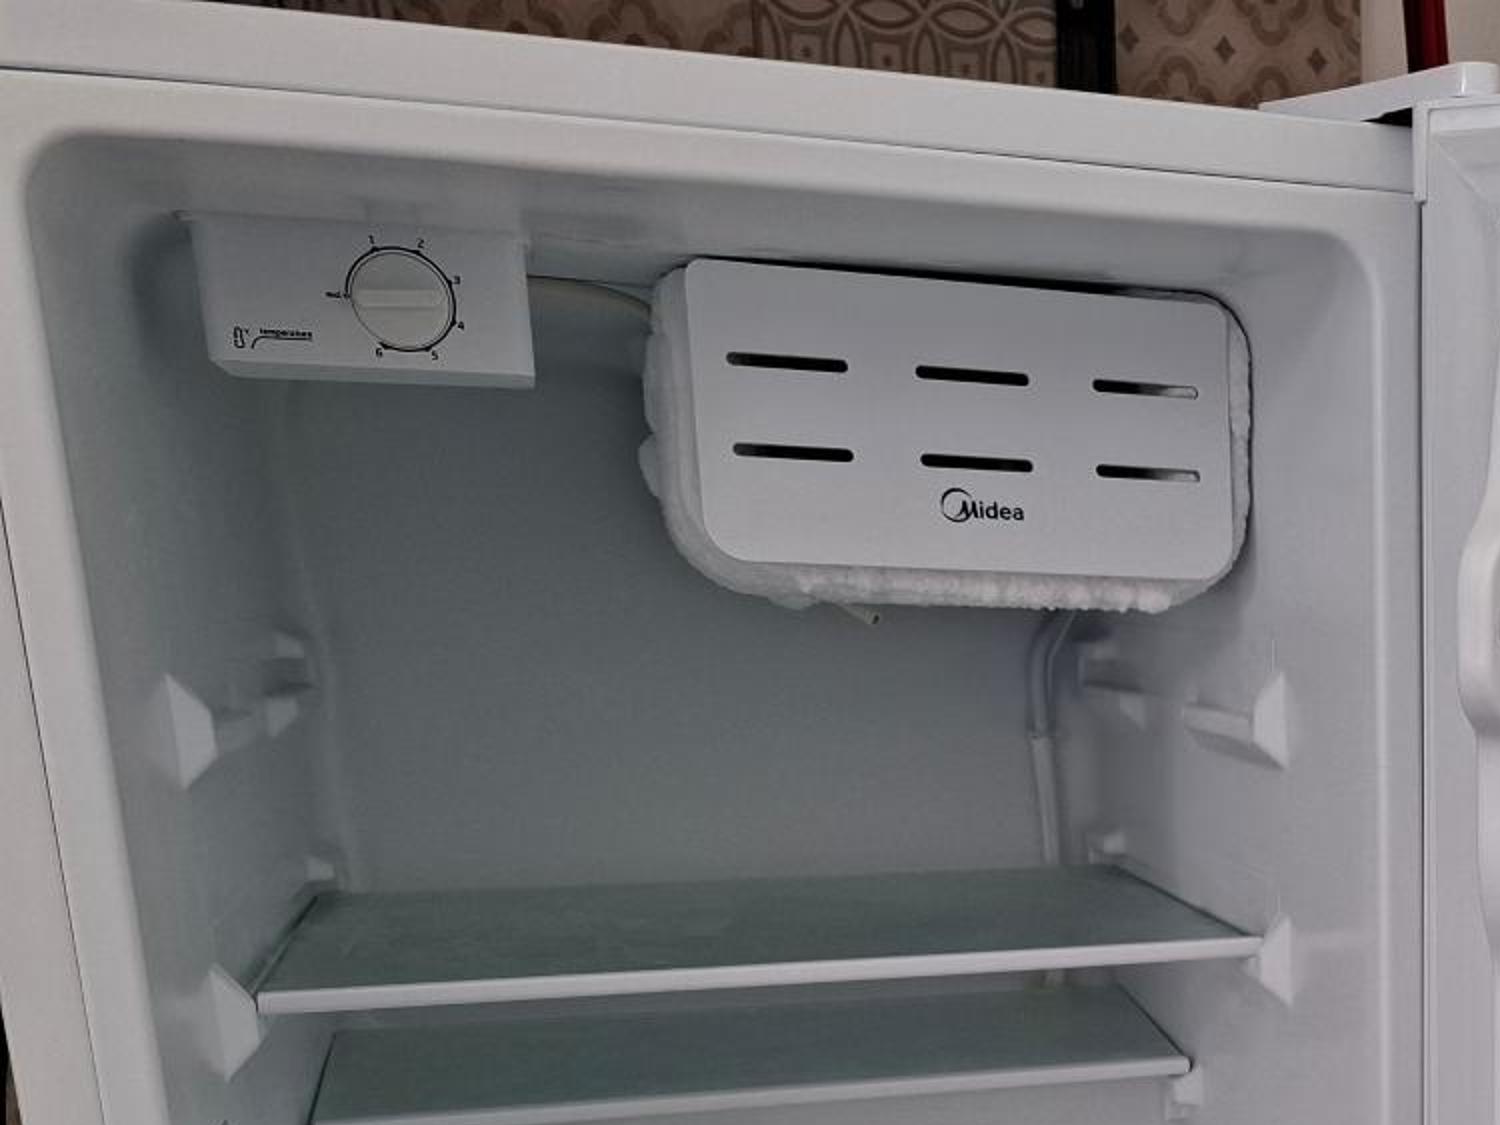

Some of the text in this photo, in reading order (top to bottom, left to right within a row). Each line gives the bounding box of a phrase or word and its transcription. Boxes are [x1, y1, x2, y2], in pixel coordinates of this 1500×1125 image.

[367, 234, 376, 245] 1
[417, 237, 426, 249] 2
[452, 275, 461, 285] 3
[457, 320, 465, 331] 4
[375, 347, 384, 359] 6
[431, 350, 440, 361] 5
[942, 490, 1025, 522] Midea
